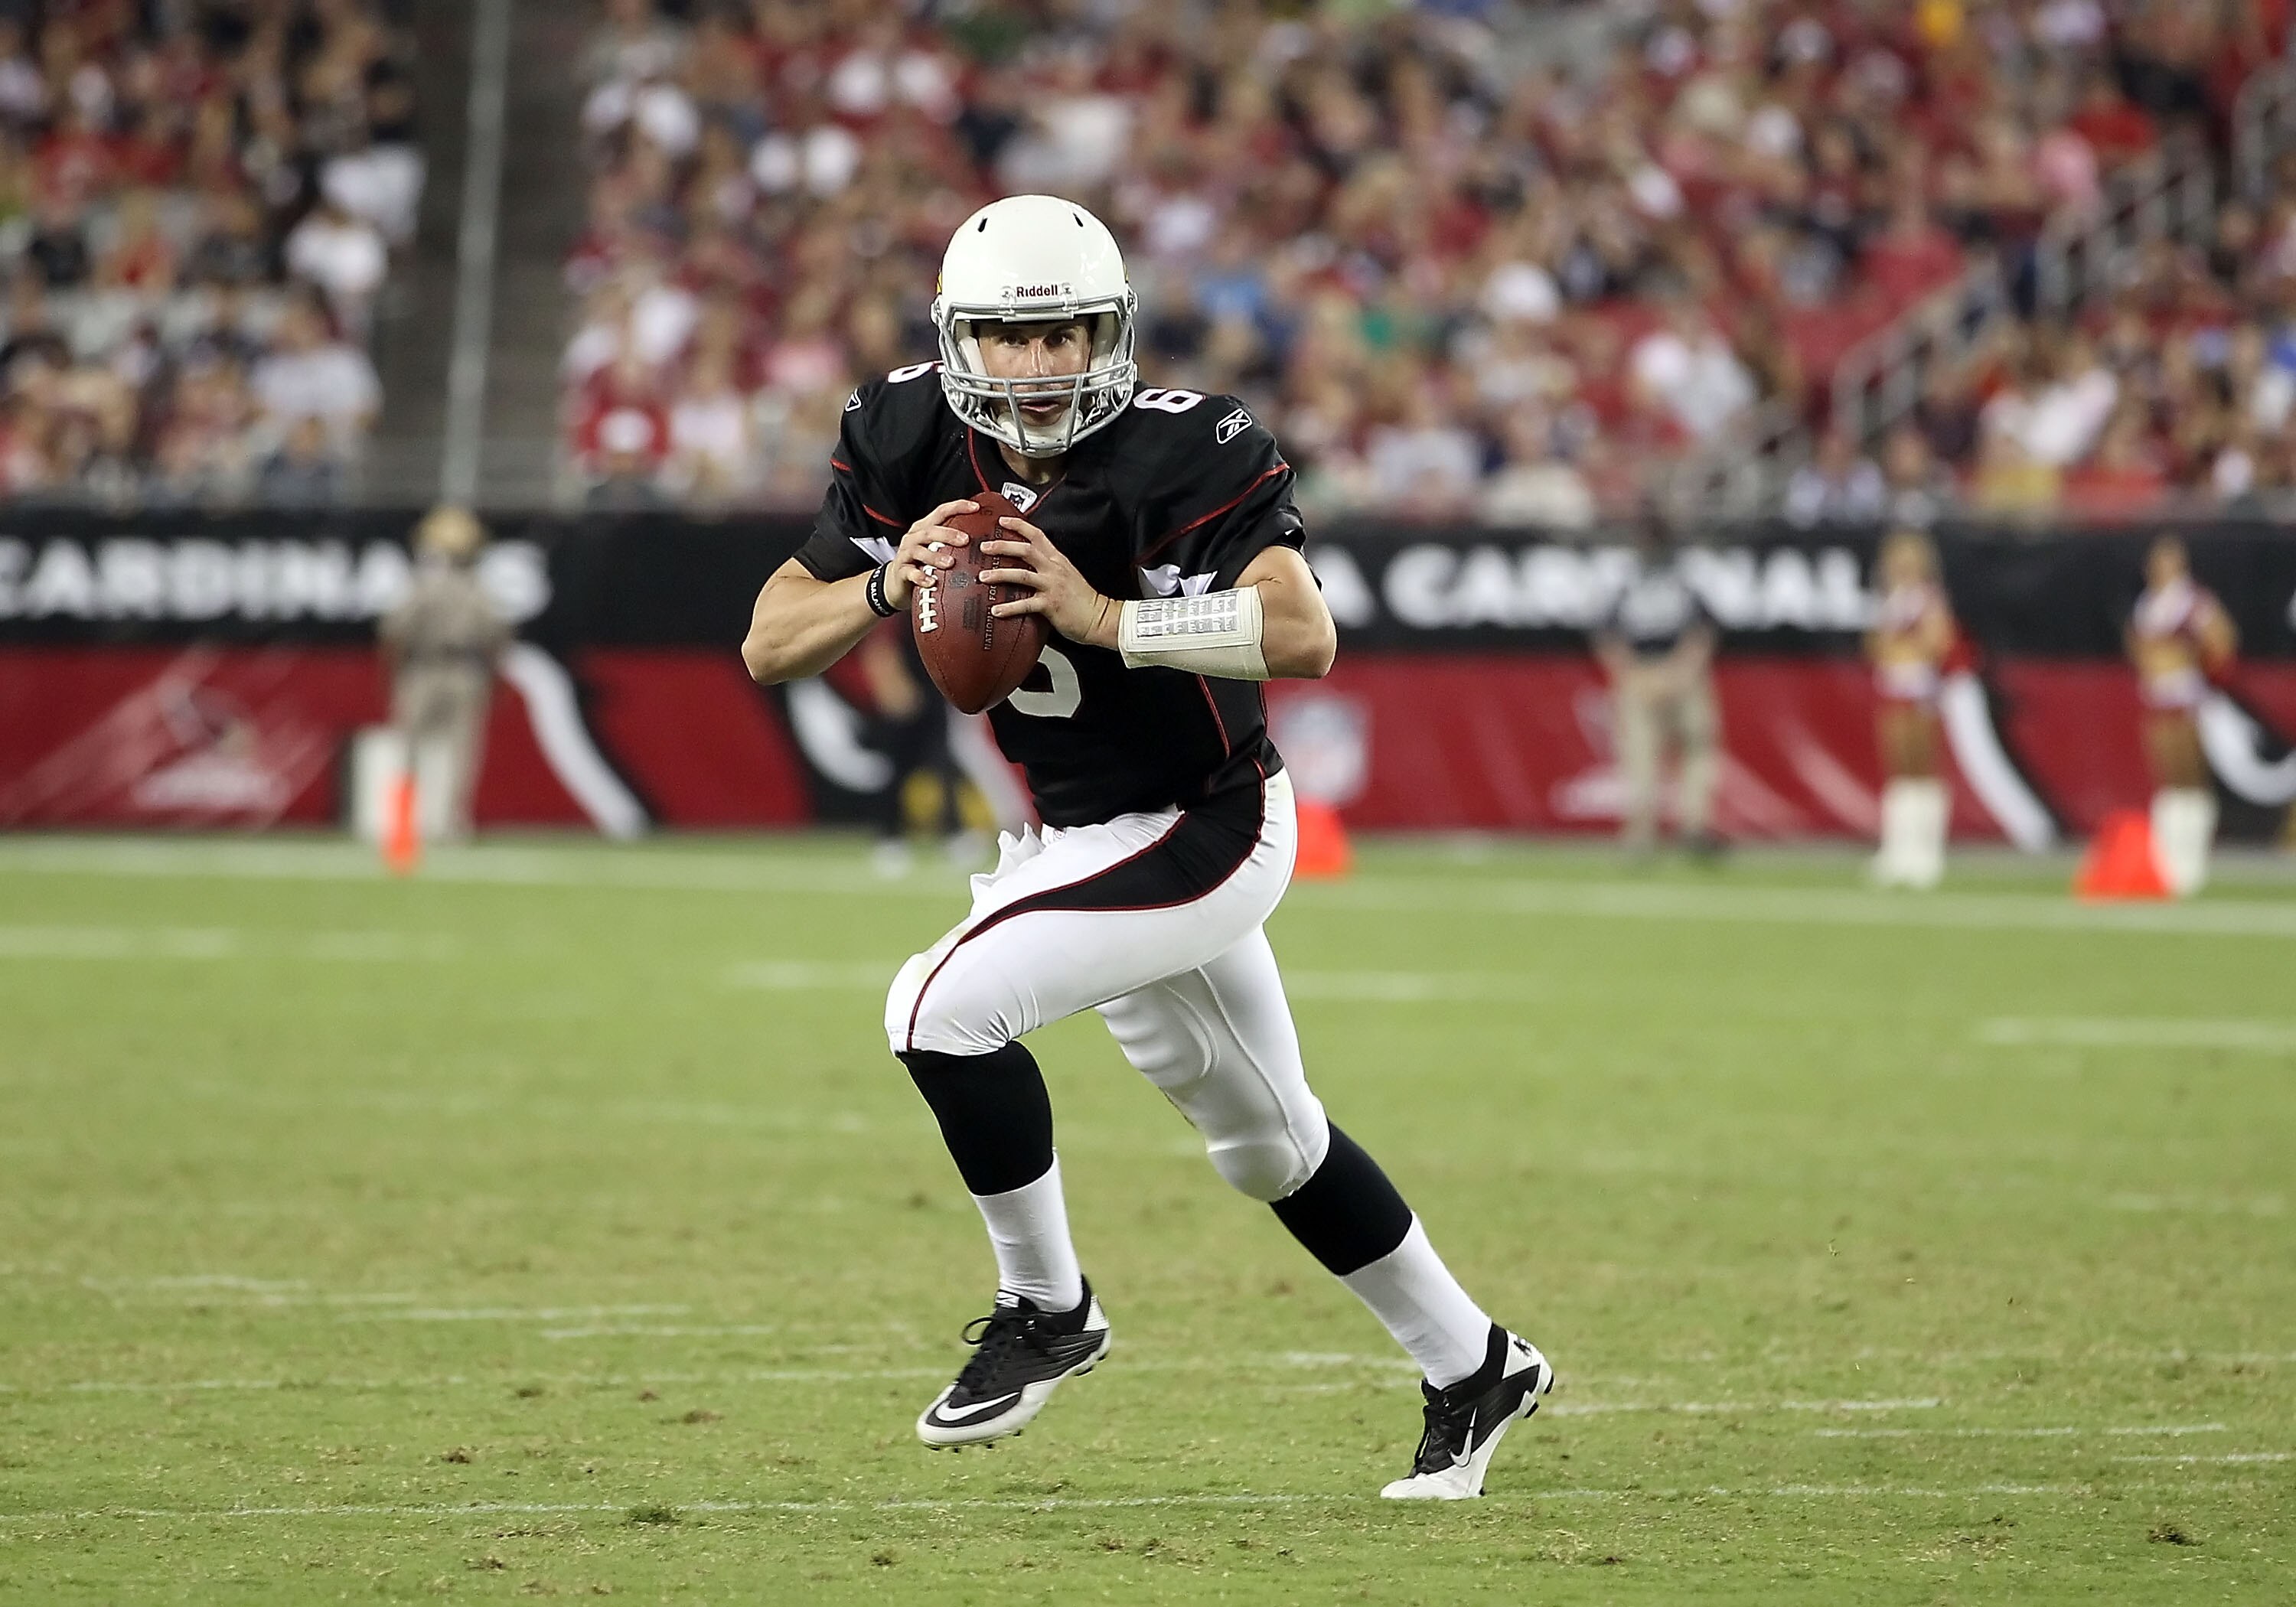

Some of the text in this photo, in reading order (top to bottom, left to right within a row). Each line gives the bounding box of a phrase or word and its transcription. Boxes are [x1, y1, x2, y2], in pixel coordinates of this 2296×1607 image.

[1016, 284, 1058, 297] Riddell
[1133, 389, 1204, 414] 6
[0, 538, 550, 618] ARDINAS
[984, 606, 993, 650] NATION
